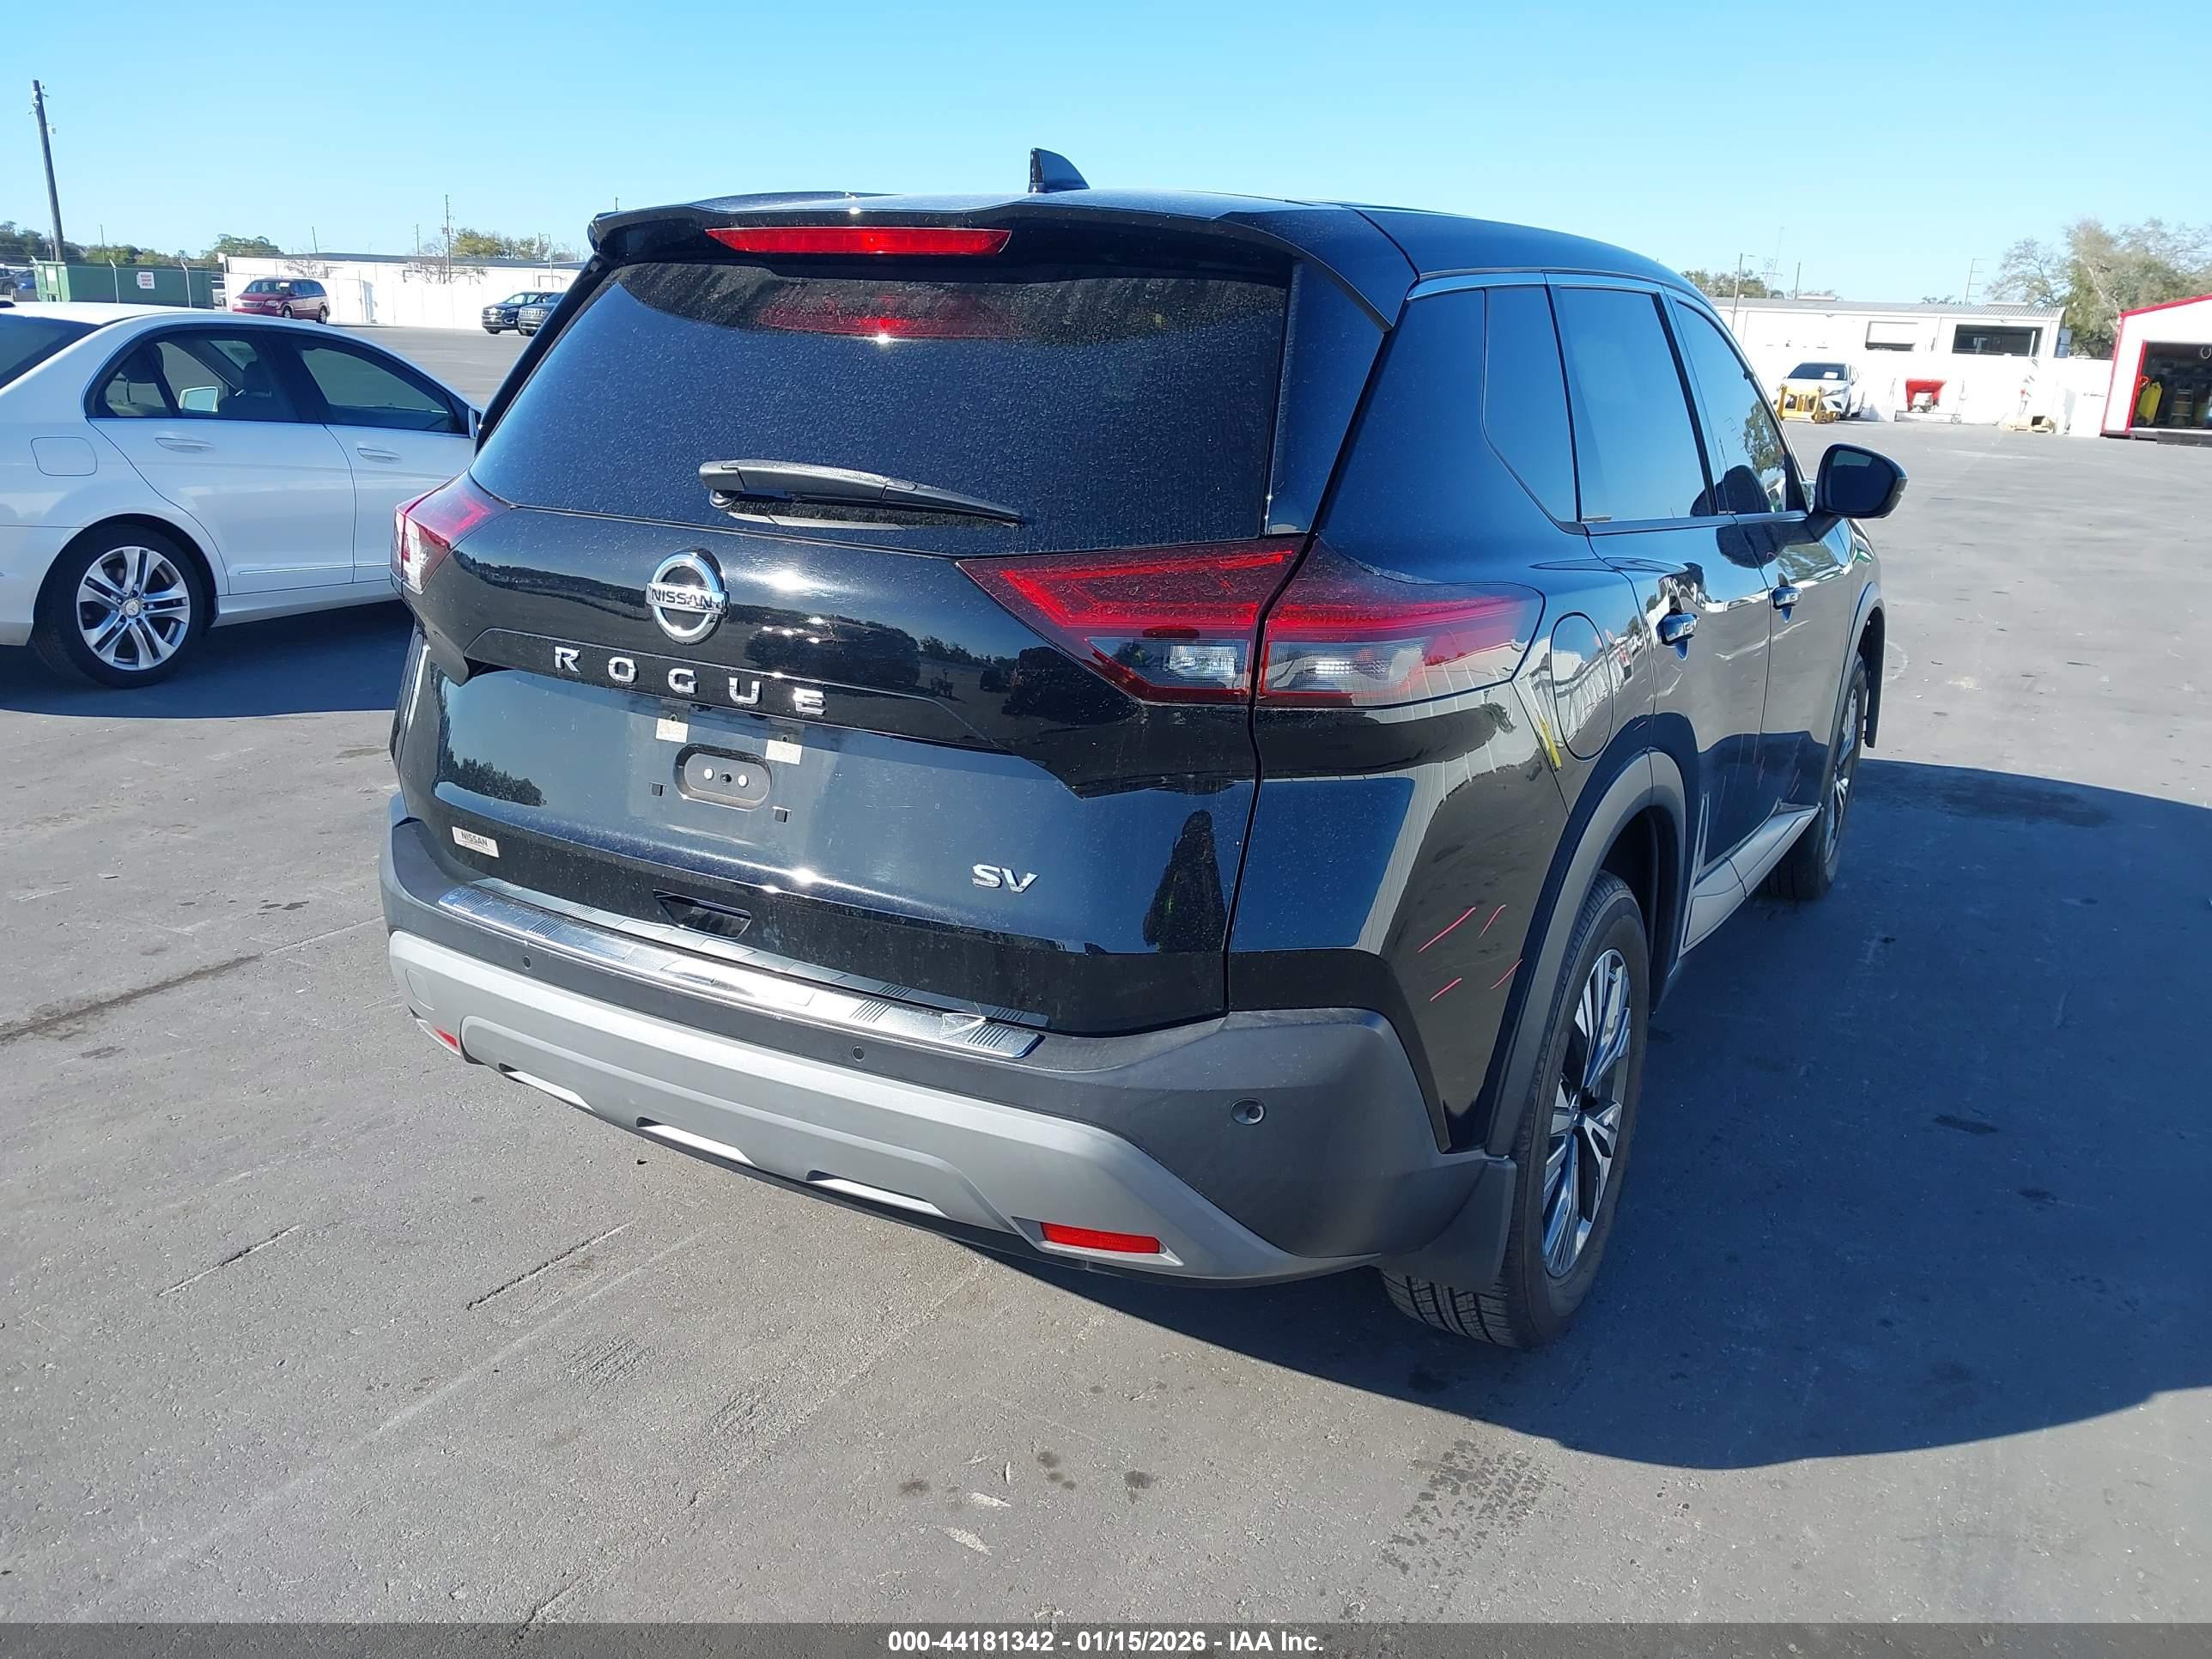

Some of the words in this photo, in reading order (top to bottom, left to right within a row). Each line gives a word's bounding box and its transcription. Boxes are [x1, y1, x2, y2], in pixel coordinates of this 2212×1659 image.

[651, 587, 714, 611] NISSAN
[554, 645, 827, 715] ROGUE
[460, 830, 489, 848] NISSAN
[971, 863, 1040, 893] SV
